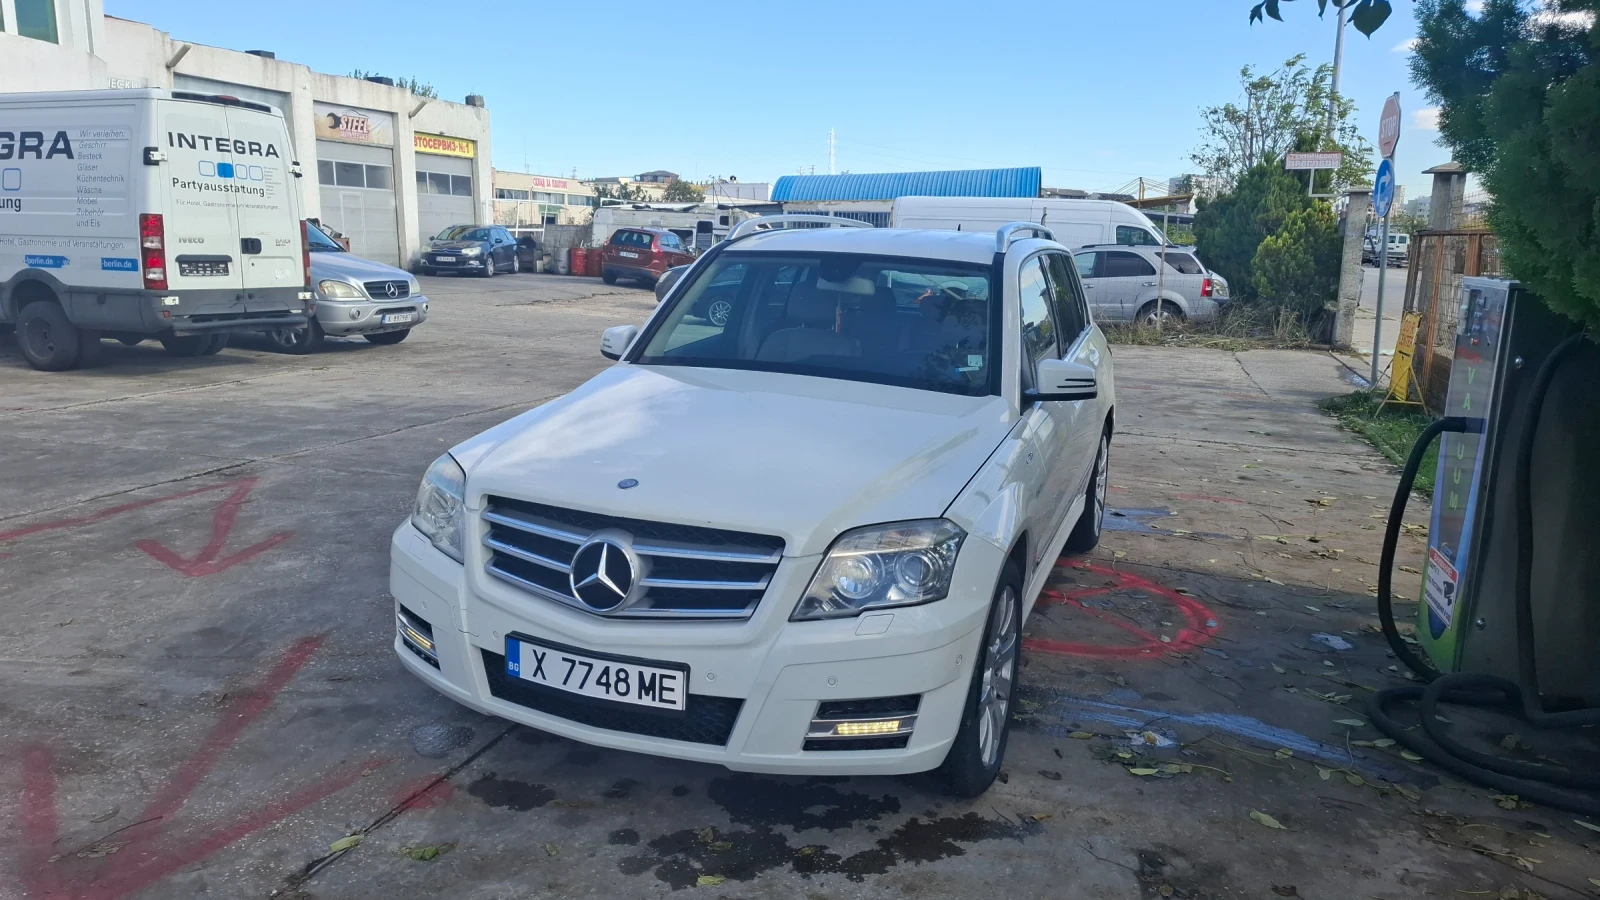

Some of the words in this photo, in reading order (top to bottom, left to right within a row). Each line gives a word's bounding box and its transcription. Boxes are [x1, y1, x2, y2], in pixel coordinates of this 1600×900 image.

[340, 115, 369, 134] STEEL
[1381, 115, 1397, 139] STOP
[79, 129, 91, 138] Wir
[93, 129, 126, 138] verleihen:
[78, 141, 107, 149] Geschirr
[168, 132, 279, 158] INTEGRA
[77, 152, 103, 160] Besteck
[77, 163, 99, 172] Gläser
[76, 175, 125, 183] Küchentechnik
[76, 185, 103, 194] Wäsche
[172, 177, 265, 197] Partyausstattung
[76, 207, 105, 217] Zubehör
[76, 219, 89, 227] und
[90, 219, 101, 227] Eis
[18, 238, 57, 248] Gastronomie
[58, 240, 71, 248] und
[72, 240, 125, 251] Veranstaltungen.
[1449, 367, 1476, 511] VAUUM
[508, 661, 519, 672] BG
[532, 649, 547, 680] X
[561, 656, 631, 697] 7748
[637, 670, 677, 705] ME
